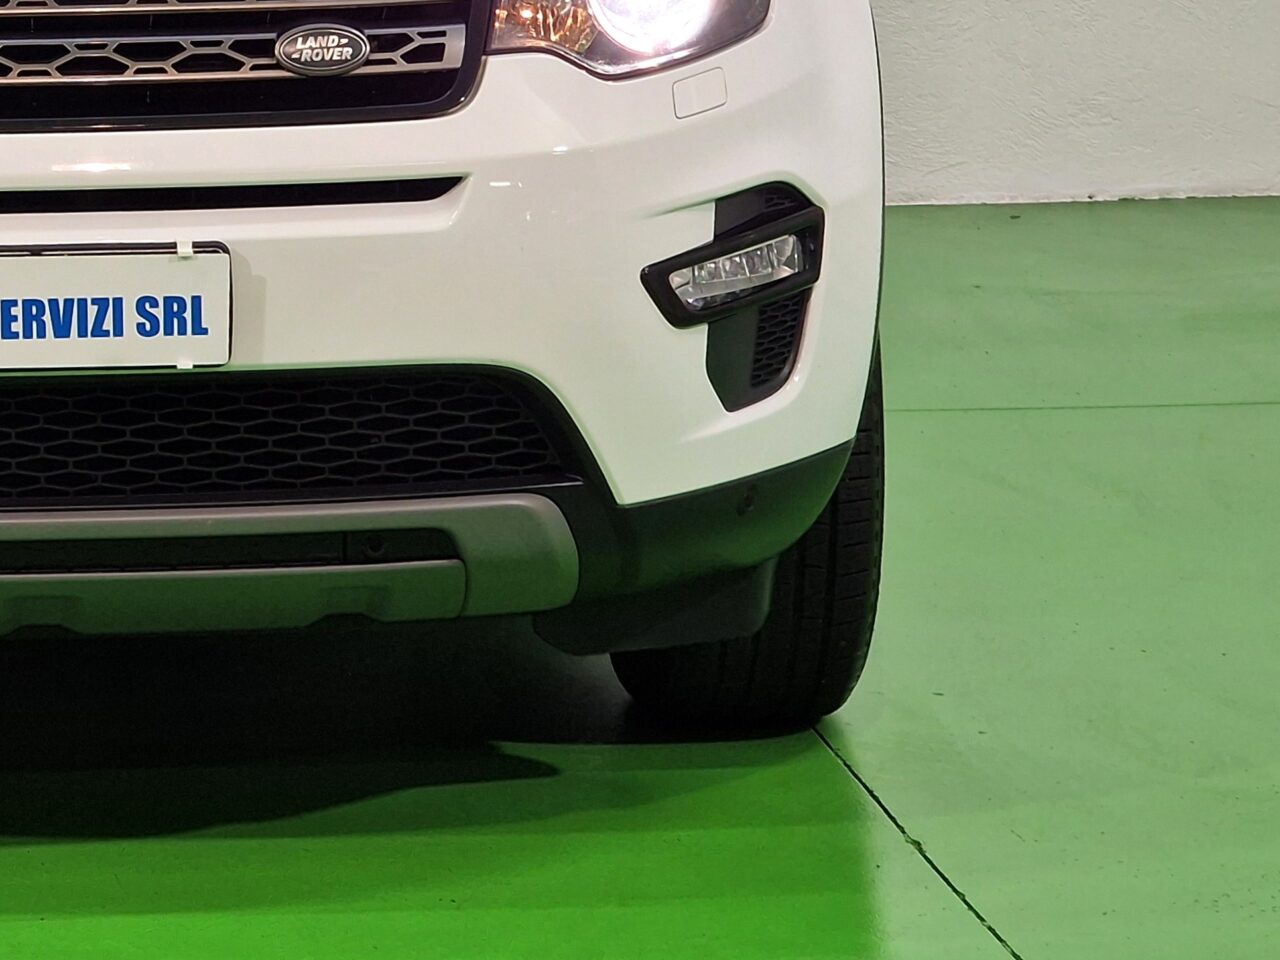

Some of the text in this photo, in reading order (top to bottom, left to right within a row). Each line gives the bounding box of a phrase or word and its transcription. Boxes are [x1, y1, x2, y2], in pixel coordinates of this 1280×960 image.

[296, 34, 339, 50] LAND
[300, 47, 353, 62] ROVER
[135, 295, 209, 338] SRL
